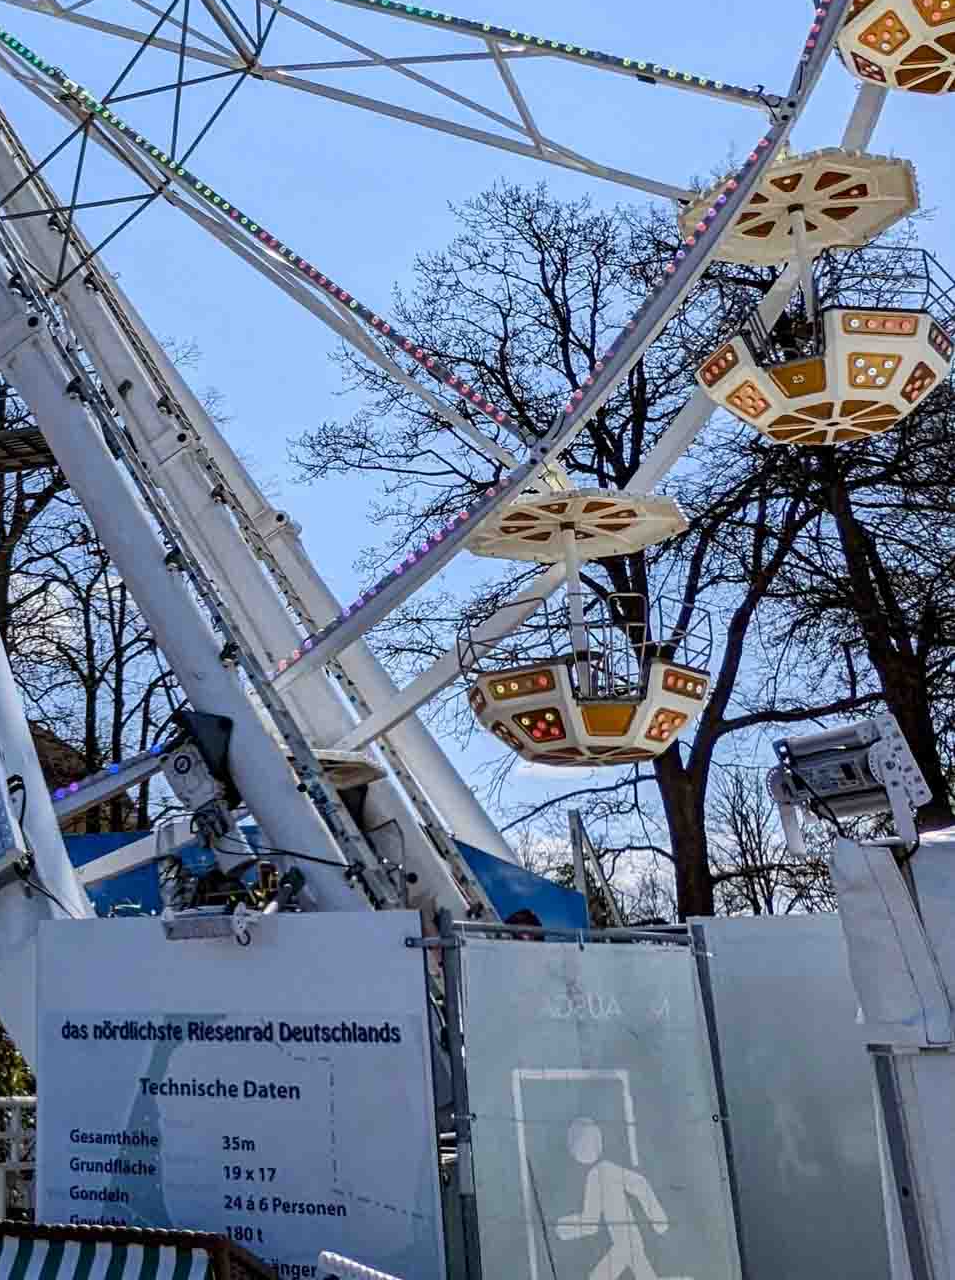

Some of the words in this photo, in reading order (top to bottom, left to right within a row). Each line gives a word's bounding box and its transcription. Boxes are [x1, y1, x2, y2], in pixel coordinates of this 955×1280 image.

[61, 1021, 88, 1040] das
[93, 1020, 182, 1041] nördlichste
[187, 1022, 273, 1042] Riesenrad
[279, 1022, 402, 1043] Deutschlands
[139, 1077, 238, 1098] Technische
[244, 1080, 301, 1099] Daten
[69, 1128, 159, 1147] Gesamthöhe
[222, 1136, 256, 1152] 35m
[69, 1157, 158, 1176] Grundfläche
[223, 1166, 242, 1181] 19
[259, 1167, 277, 1182] 17
[69, 1186, 130, 1203] Gondeln
[223, 1195, 243, 1211] 24
[259, 1197, 269, 1212] 6
[272, 1198, 347, 1217] Personen
[226, 1225, 254, 1241] 180
